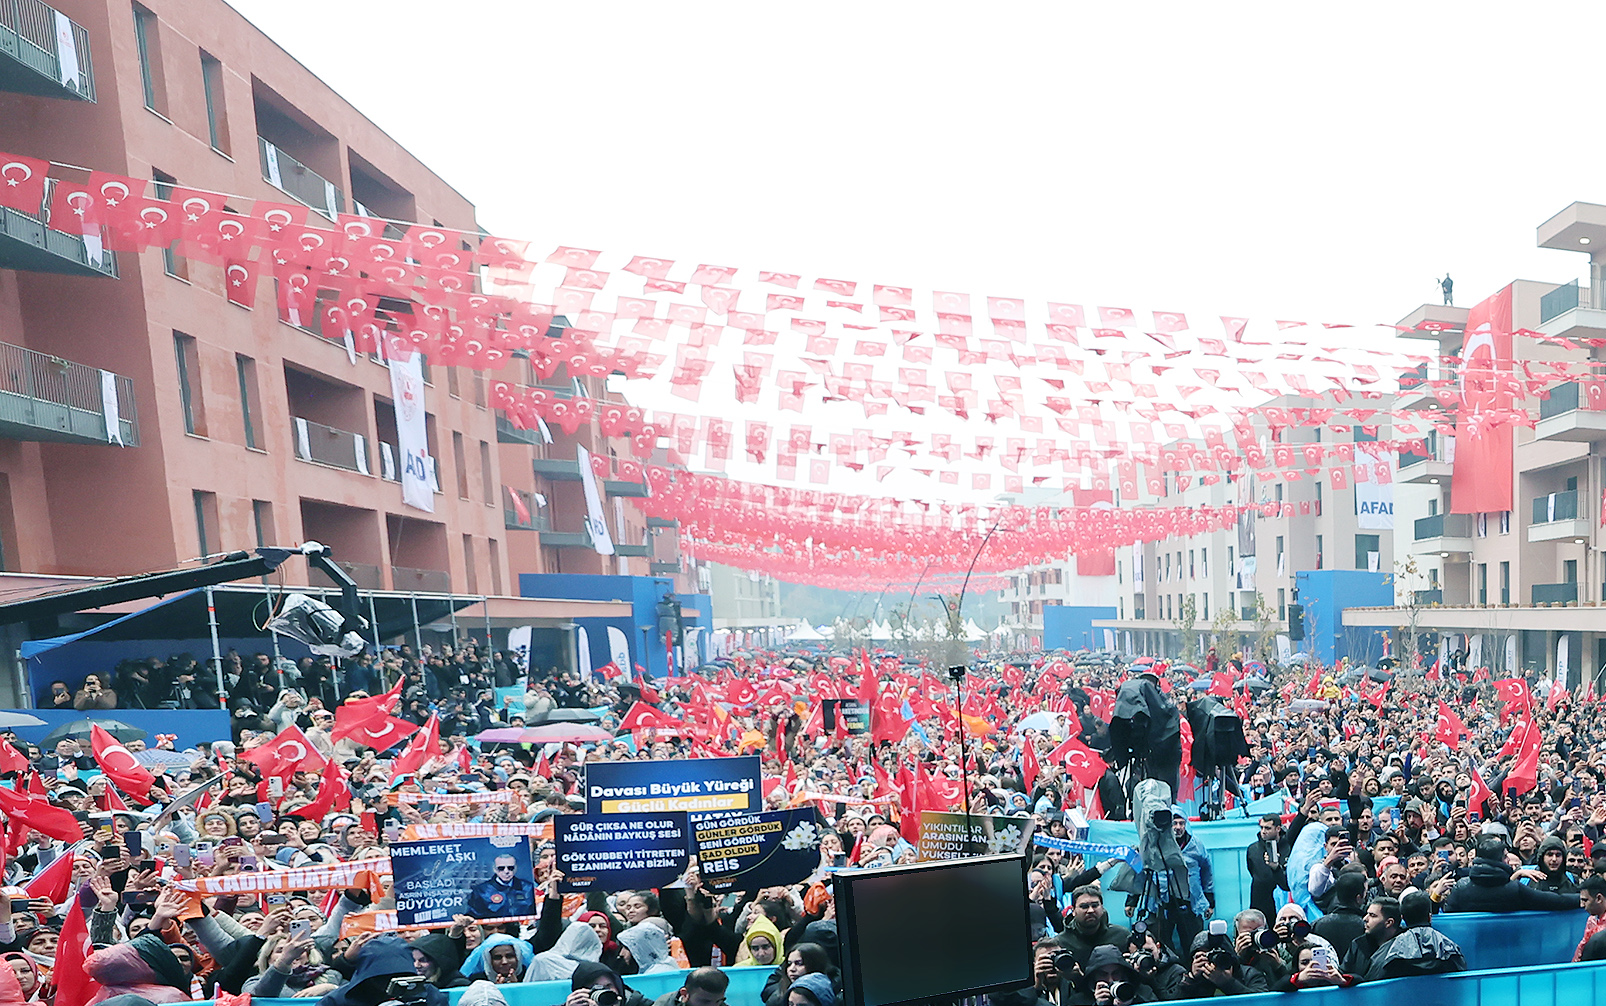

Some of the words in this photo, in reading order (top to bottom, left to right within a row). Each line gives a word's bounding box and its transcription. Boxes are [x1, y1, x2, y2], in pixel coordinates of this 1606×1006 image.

[590, 786, 646, 798] Davası
[650, 783, 700, 797] Büyük
[703, 778, 754, 793] Yüreği
[668, 797, 733, 811] Kadınlar
[570, 821, 594, 832] GÜR
[596, 821, 628, 833] ÇIKSA
[629, 821, 644, 830] NE
[646, 820, 674, 830] OLUR
[695, 820, 718, 831] GÜN
[719, 815, 762, 827] GÖRDÜK
[615, 830, 656, 842] BAYKUŞ
[657, 827, 681, 839] SESİ
[698, 827, 737, 840] GÜNLER
[739, 823, 780, 834] GÖRDÜK
[699, 839, 722, 850] SENİ
[724, 834, 766, 846] GÖRDÜK
[921, 841, 963, 851] UMUDU
[391, 843, 462, 858] MEMLEKET
[446, 852, 476, 863] AŞKI
[561, 851, 586, 862] GÖK
[587, 849, 634, 862] KUBBEYİ
[634, 847, 685, 859] TİTRETEN
[701, 850, 722, 861] ŞAD
[723, 846, 757, 856] OLDUK
[571, 860, 621, 872] EZANIMIZ
[623, 860, 645, 870] VAR
[646, 857, 677, 869] BİZİM.
[702, 857, 740, 874] REİS
[205, 872, 282, 893] KADIN
[287, 867, 356, 889] HATAY
[406, 878, 456, 890] BAŞLADI
[396, 896, 463, 911] BÜYÜYOR
